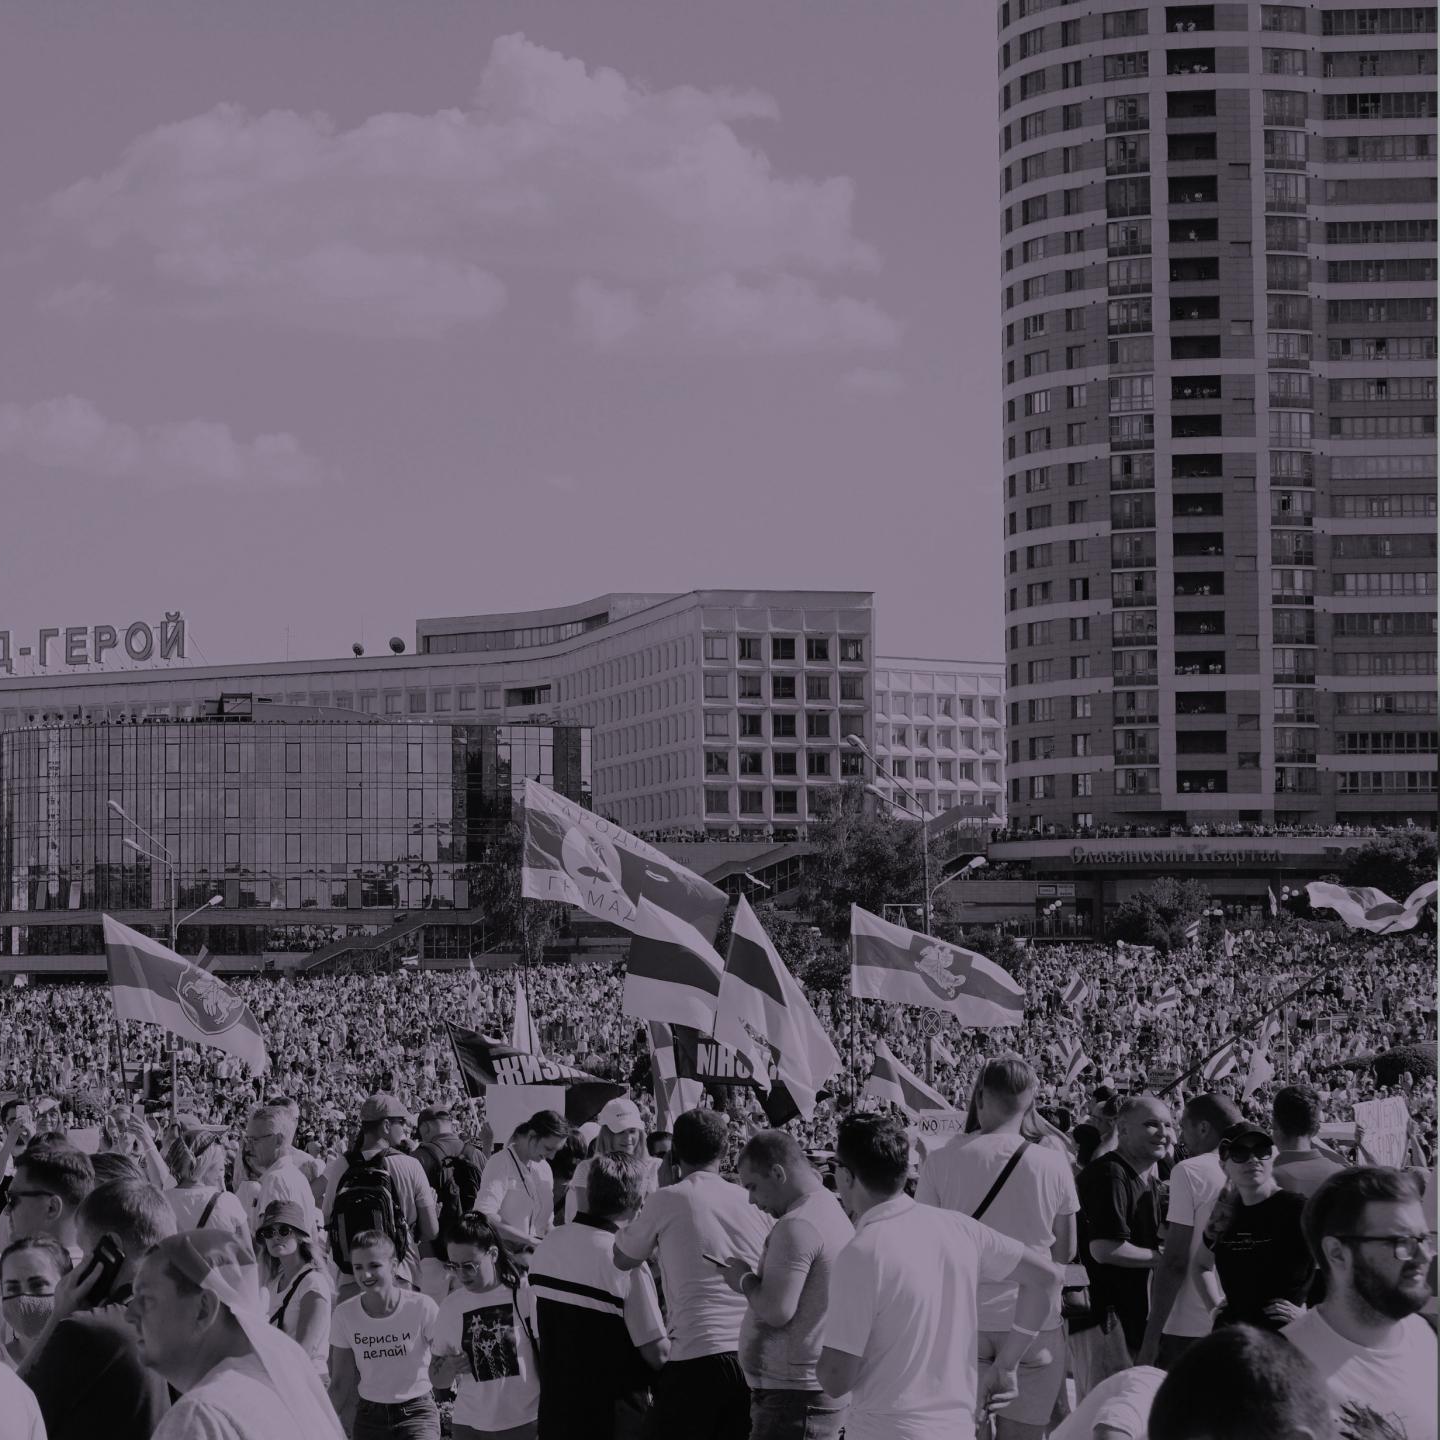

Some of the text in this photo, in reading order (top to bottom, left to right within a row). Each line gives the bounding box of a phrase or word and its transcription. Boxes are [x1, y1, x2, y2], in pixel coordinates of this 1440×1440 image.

[921, 1119, 938, 1131] NO
[354, 1331, 411, 1347] Берись и
[363, 1343, 408, 1360] делай!
